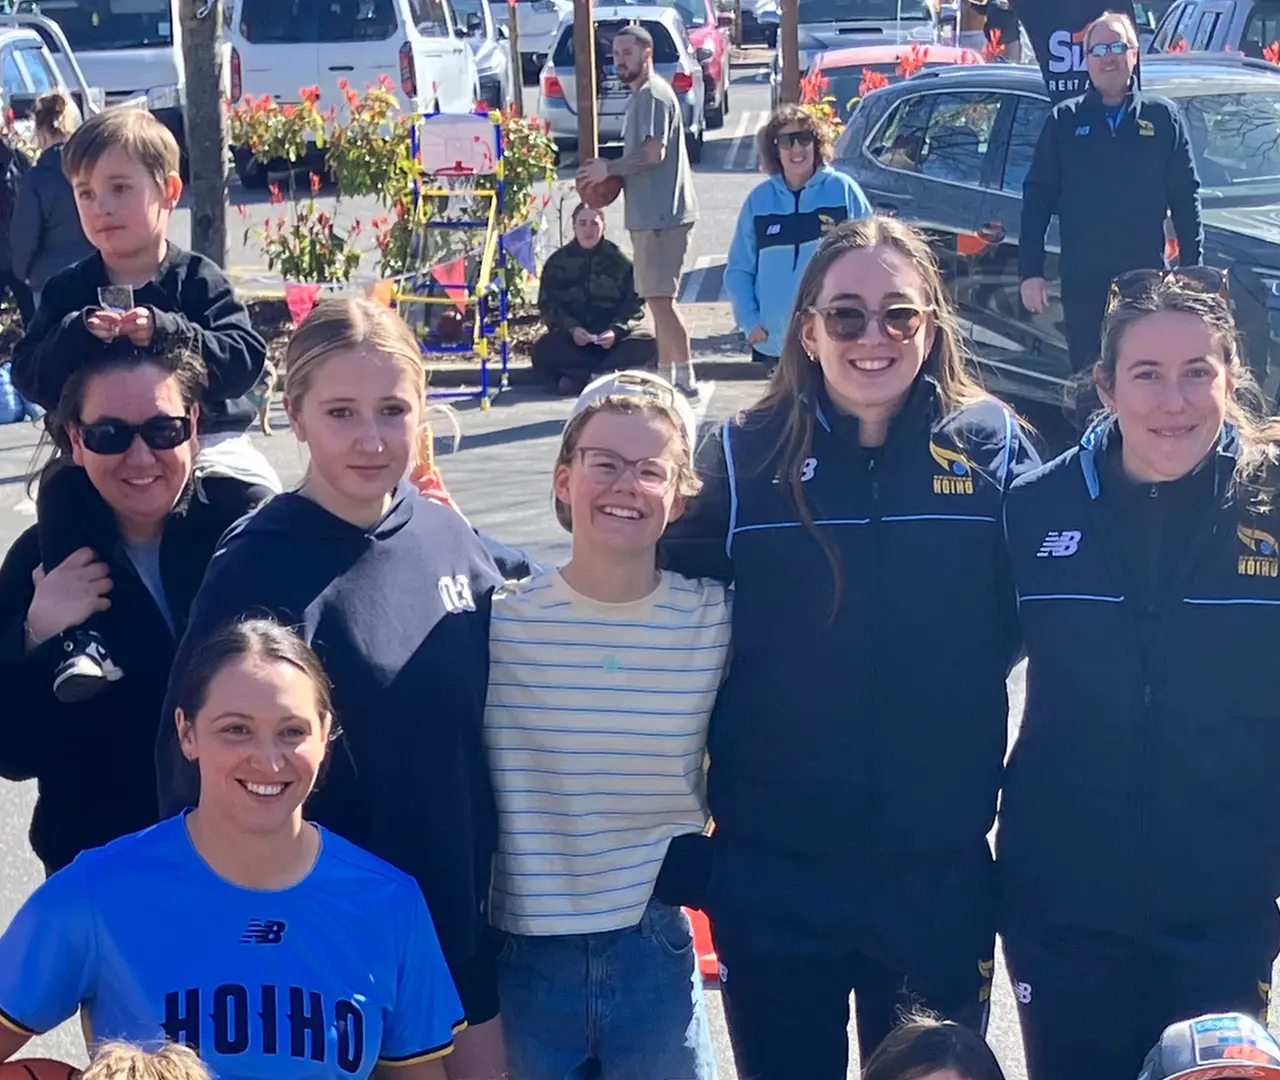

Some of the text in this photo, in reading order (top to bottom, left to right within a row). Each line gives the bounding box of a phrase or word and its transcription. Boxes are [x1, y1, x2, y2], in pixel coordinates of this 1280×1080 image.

[1049, 80, 1079, 91] RENT
[933, 479, 974, 495] HOIHO
[1036, 530, 1082, 557] NB
[1237, 559, 1279, 578] HOIHO
[159, 983, 365, 1074] HOIHO
